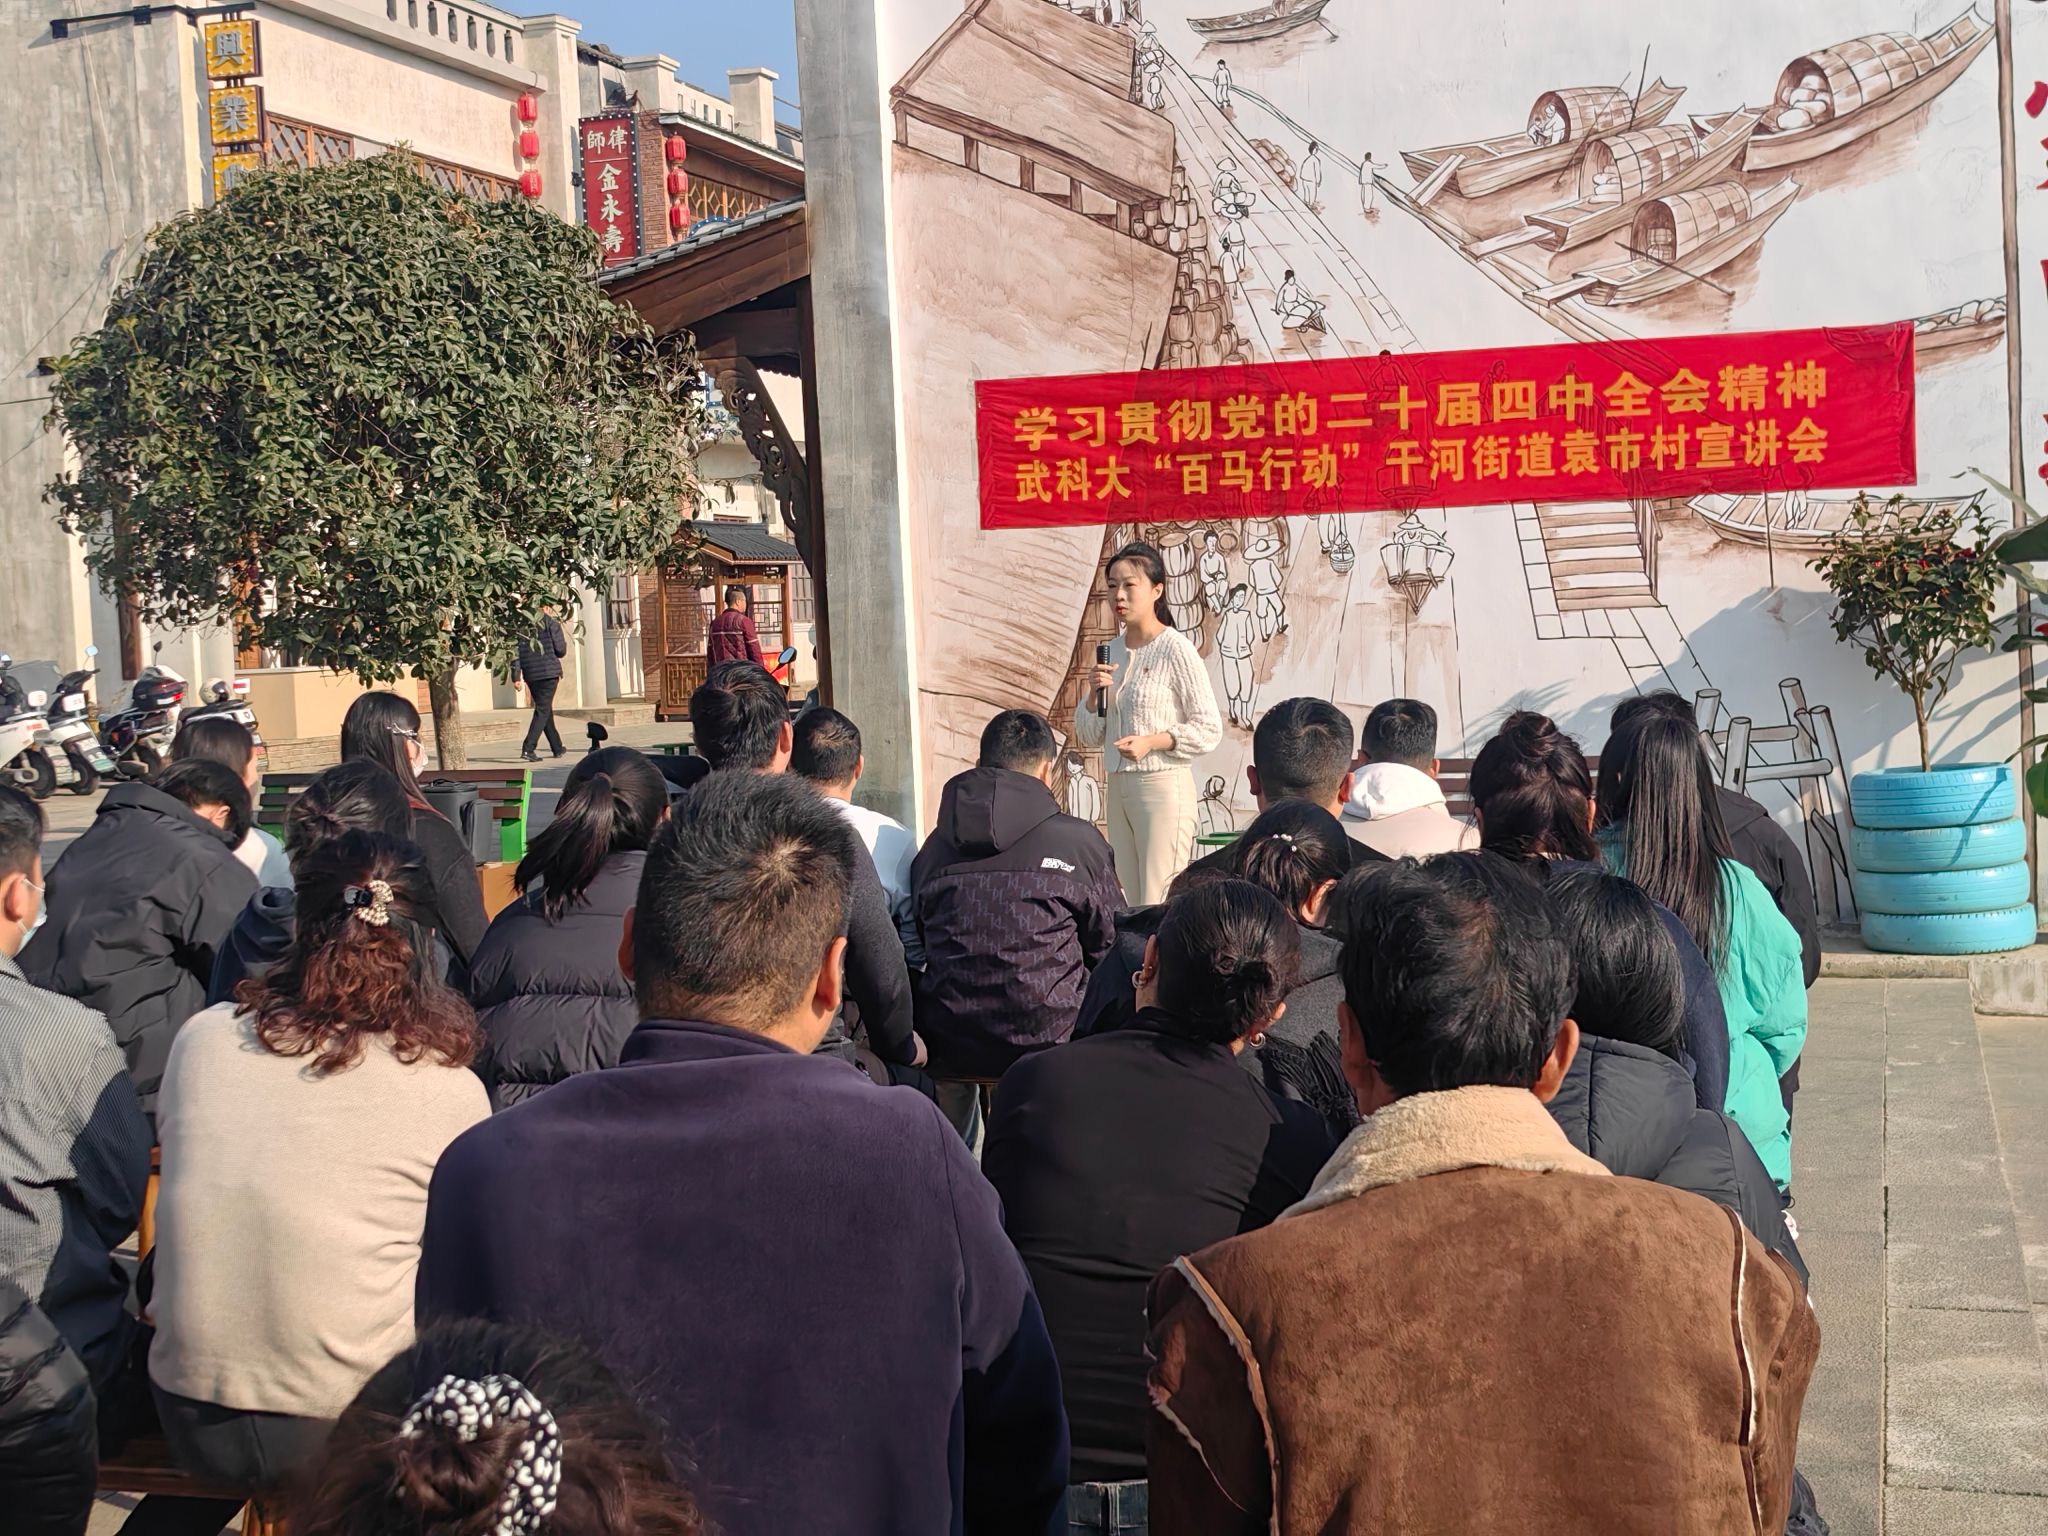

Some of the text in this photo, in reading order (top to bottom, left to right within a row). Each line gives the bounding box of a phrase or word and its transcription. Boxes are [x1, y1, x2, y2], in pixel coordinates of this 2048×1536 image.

[597, 163, 625, 253] 金永壽
[1014, 359, 1827, 451] 学习贯彻党的二十届四中全会精神
